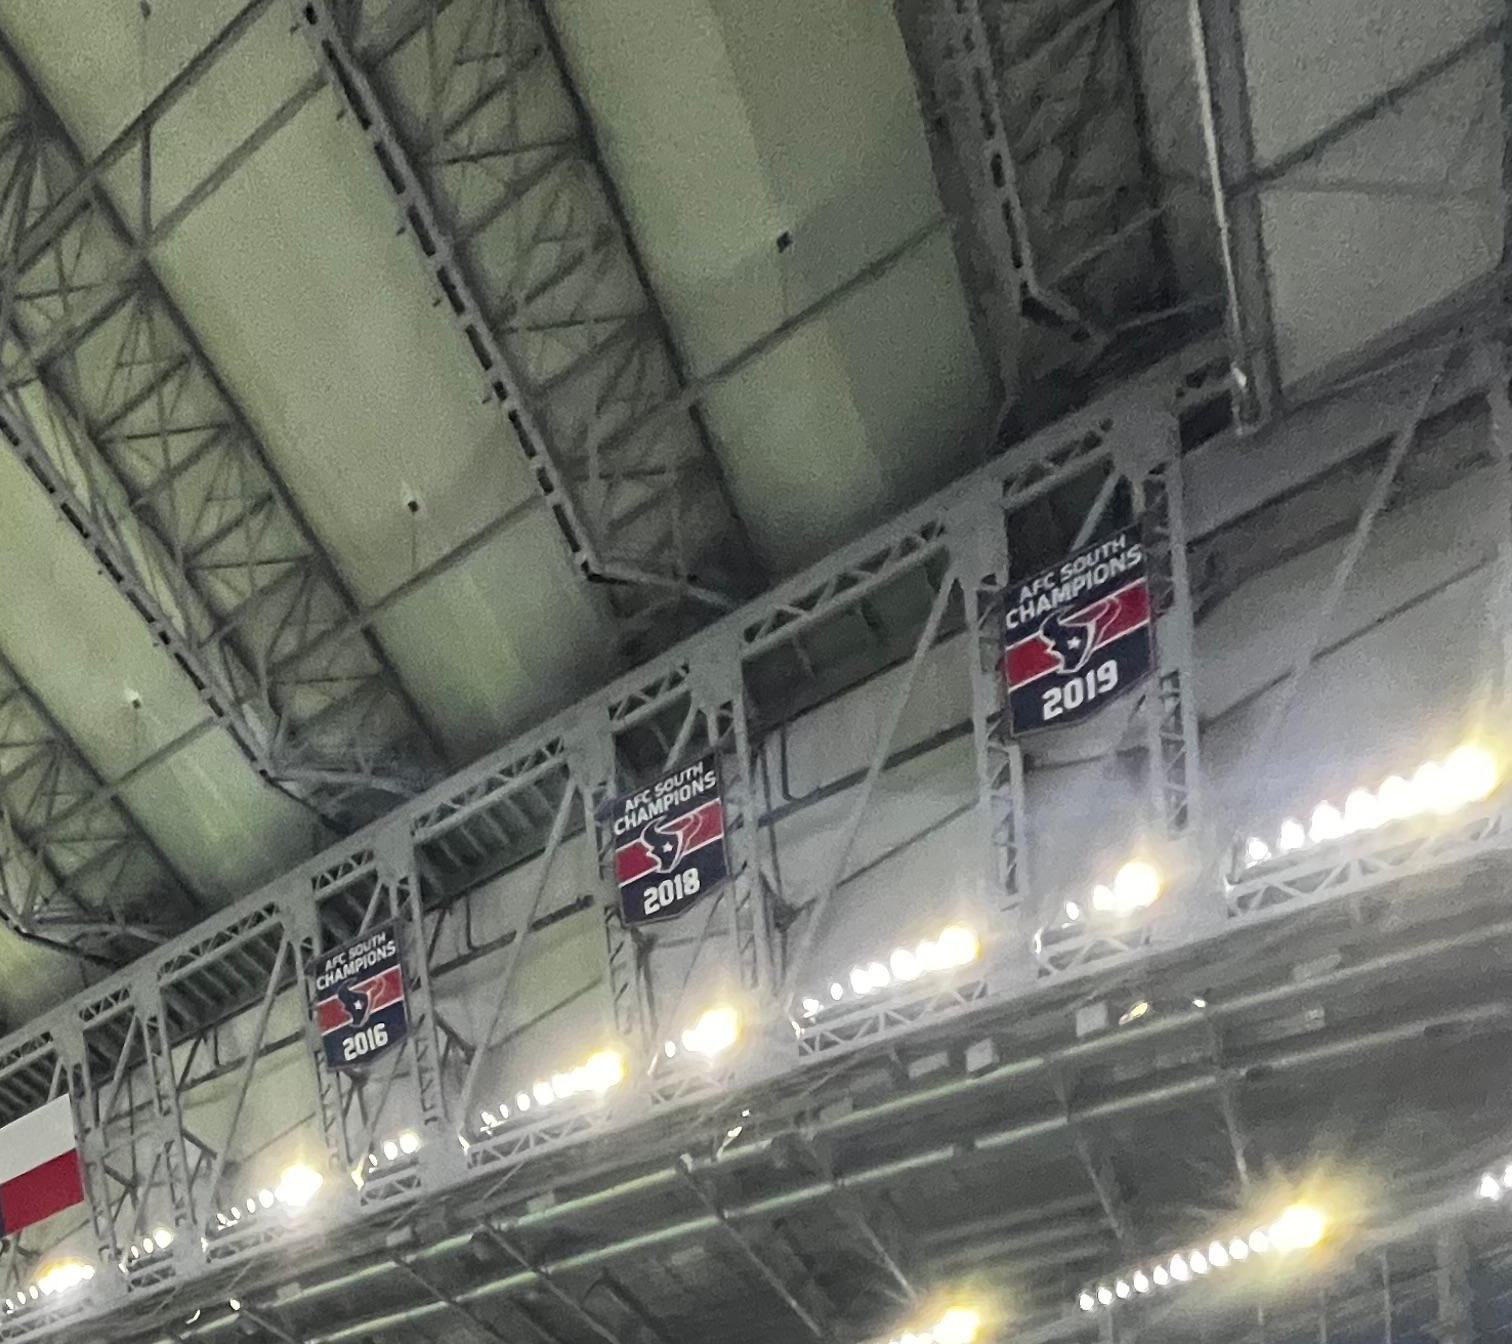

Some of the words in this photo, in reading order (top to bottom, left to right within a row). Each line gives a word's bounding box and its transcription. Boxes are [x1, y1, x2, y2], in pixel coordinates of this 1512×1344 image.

[1006, 543, 1142, 629] CHAMPIONS
[1020, 572, 1056, 604] AFC
[1060, 534, 1127, 582] SOUTH
[1042, 659, 1119, 720] 2019
[614, 770, 717, 836] CHAMPIONS
[625, 789, 653, 814] AFC
[654, 761, 704, 796] SOUTH
[643, 867, 701, 915] 2018
[316, 940, 397, 990] CHAMPIONS
[325, 952, 347, 971] AFC
[348, 932, 386, 960] SOUTH
[342, 1022, 389, 1061] 2016
